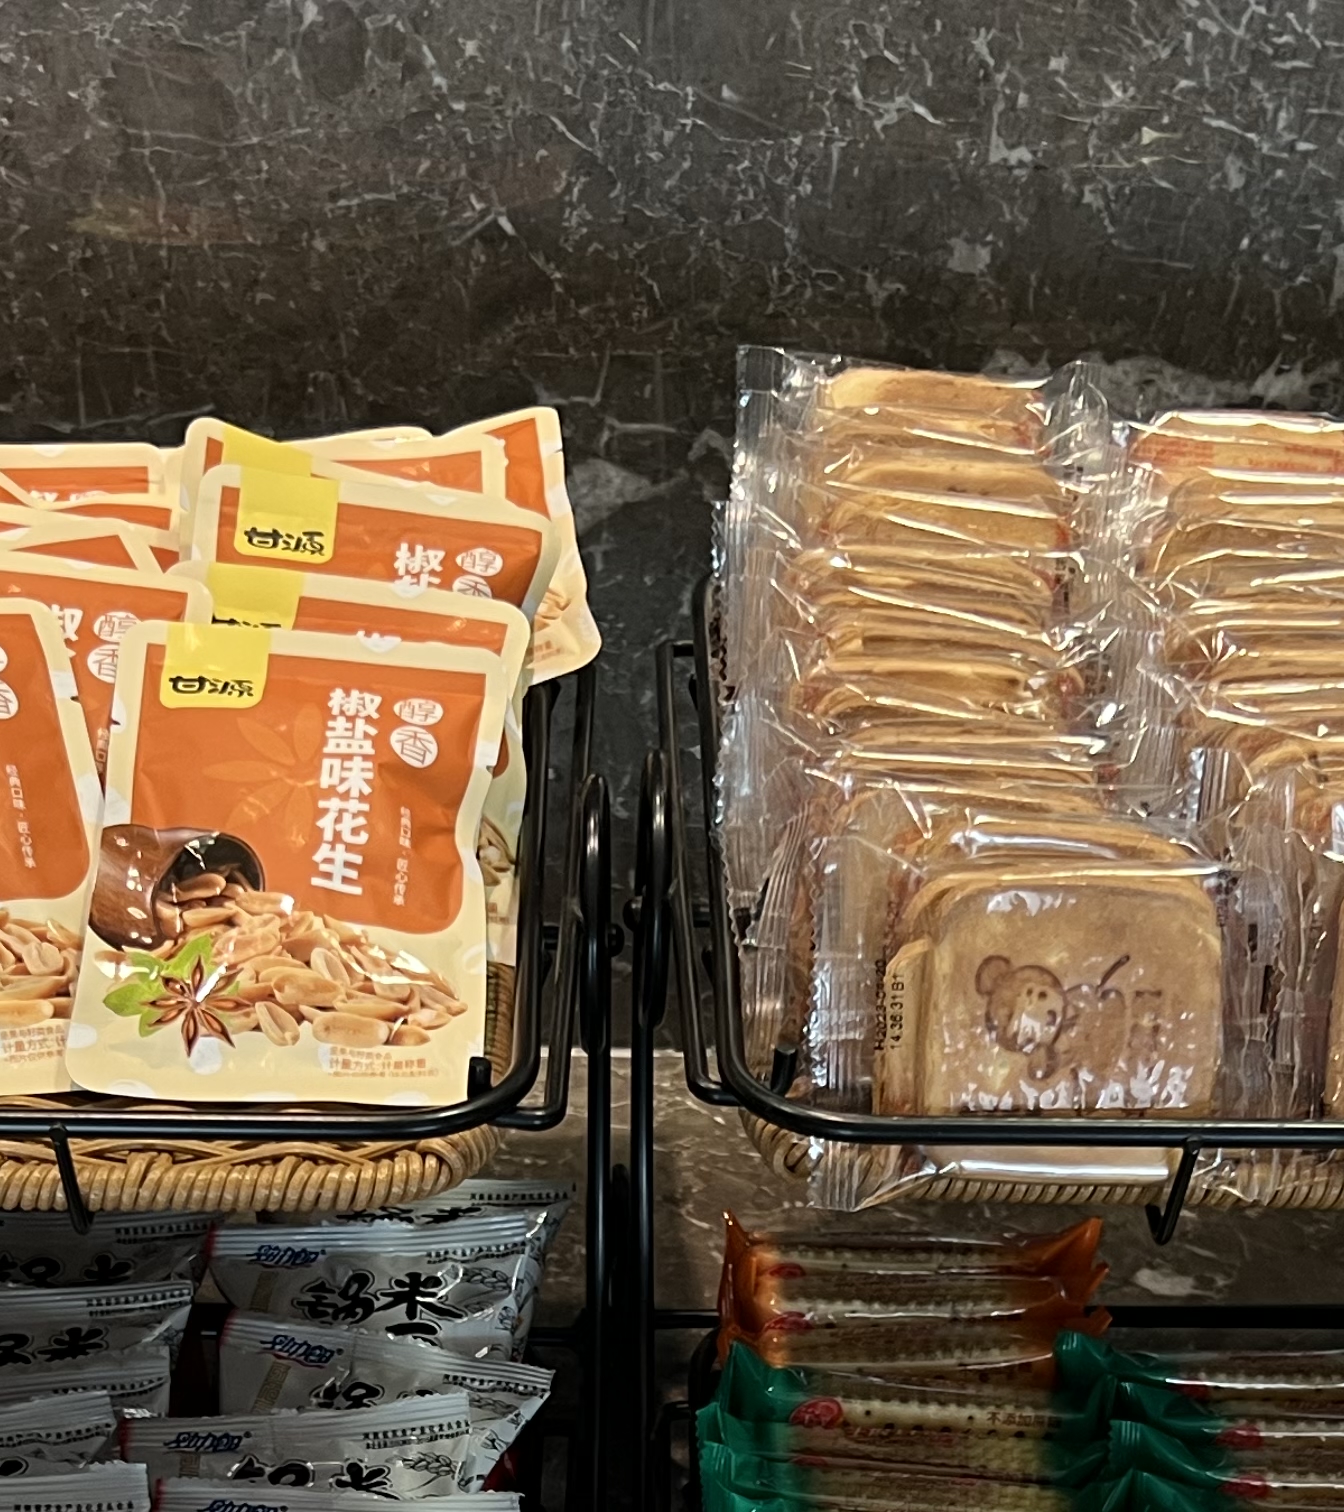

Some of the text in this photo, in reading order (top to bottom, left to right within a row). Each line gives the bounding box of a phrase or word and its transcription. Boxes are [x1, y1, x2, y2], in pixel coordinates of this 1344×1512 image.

[242, 525, 328, 558] 甘源
[167, 674, 256, 698] 甘源
[394, 699, 439, 767] 醇香
[310, 686, 384, 896] 椒盐味花生
